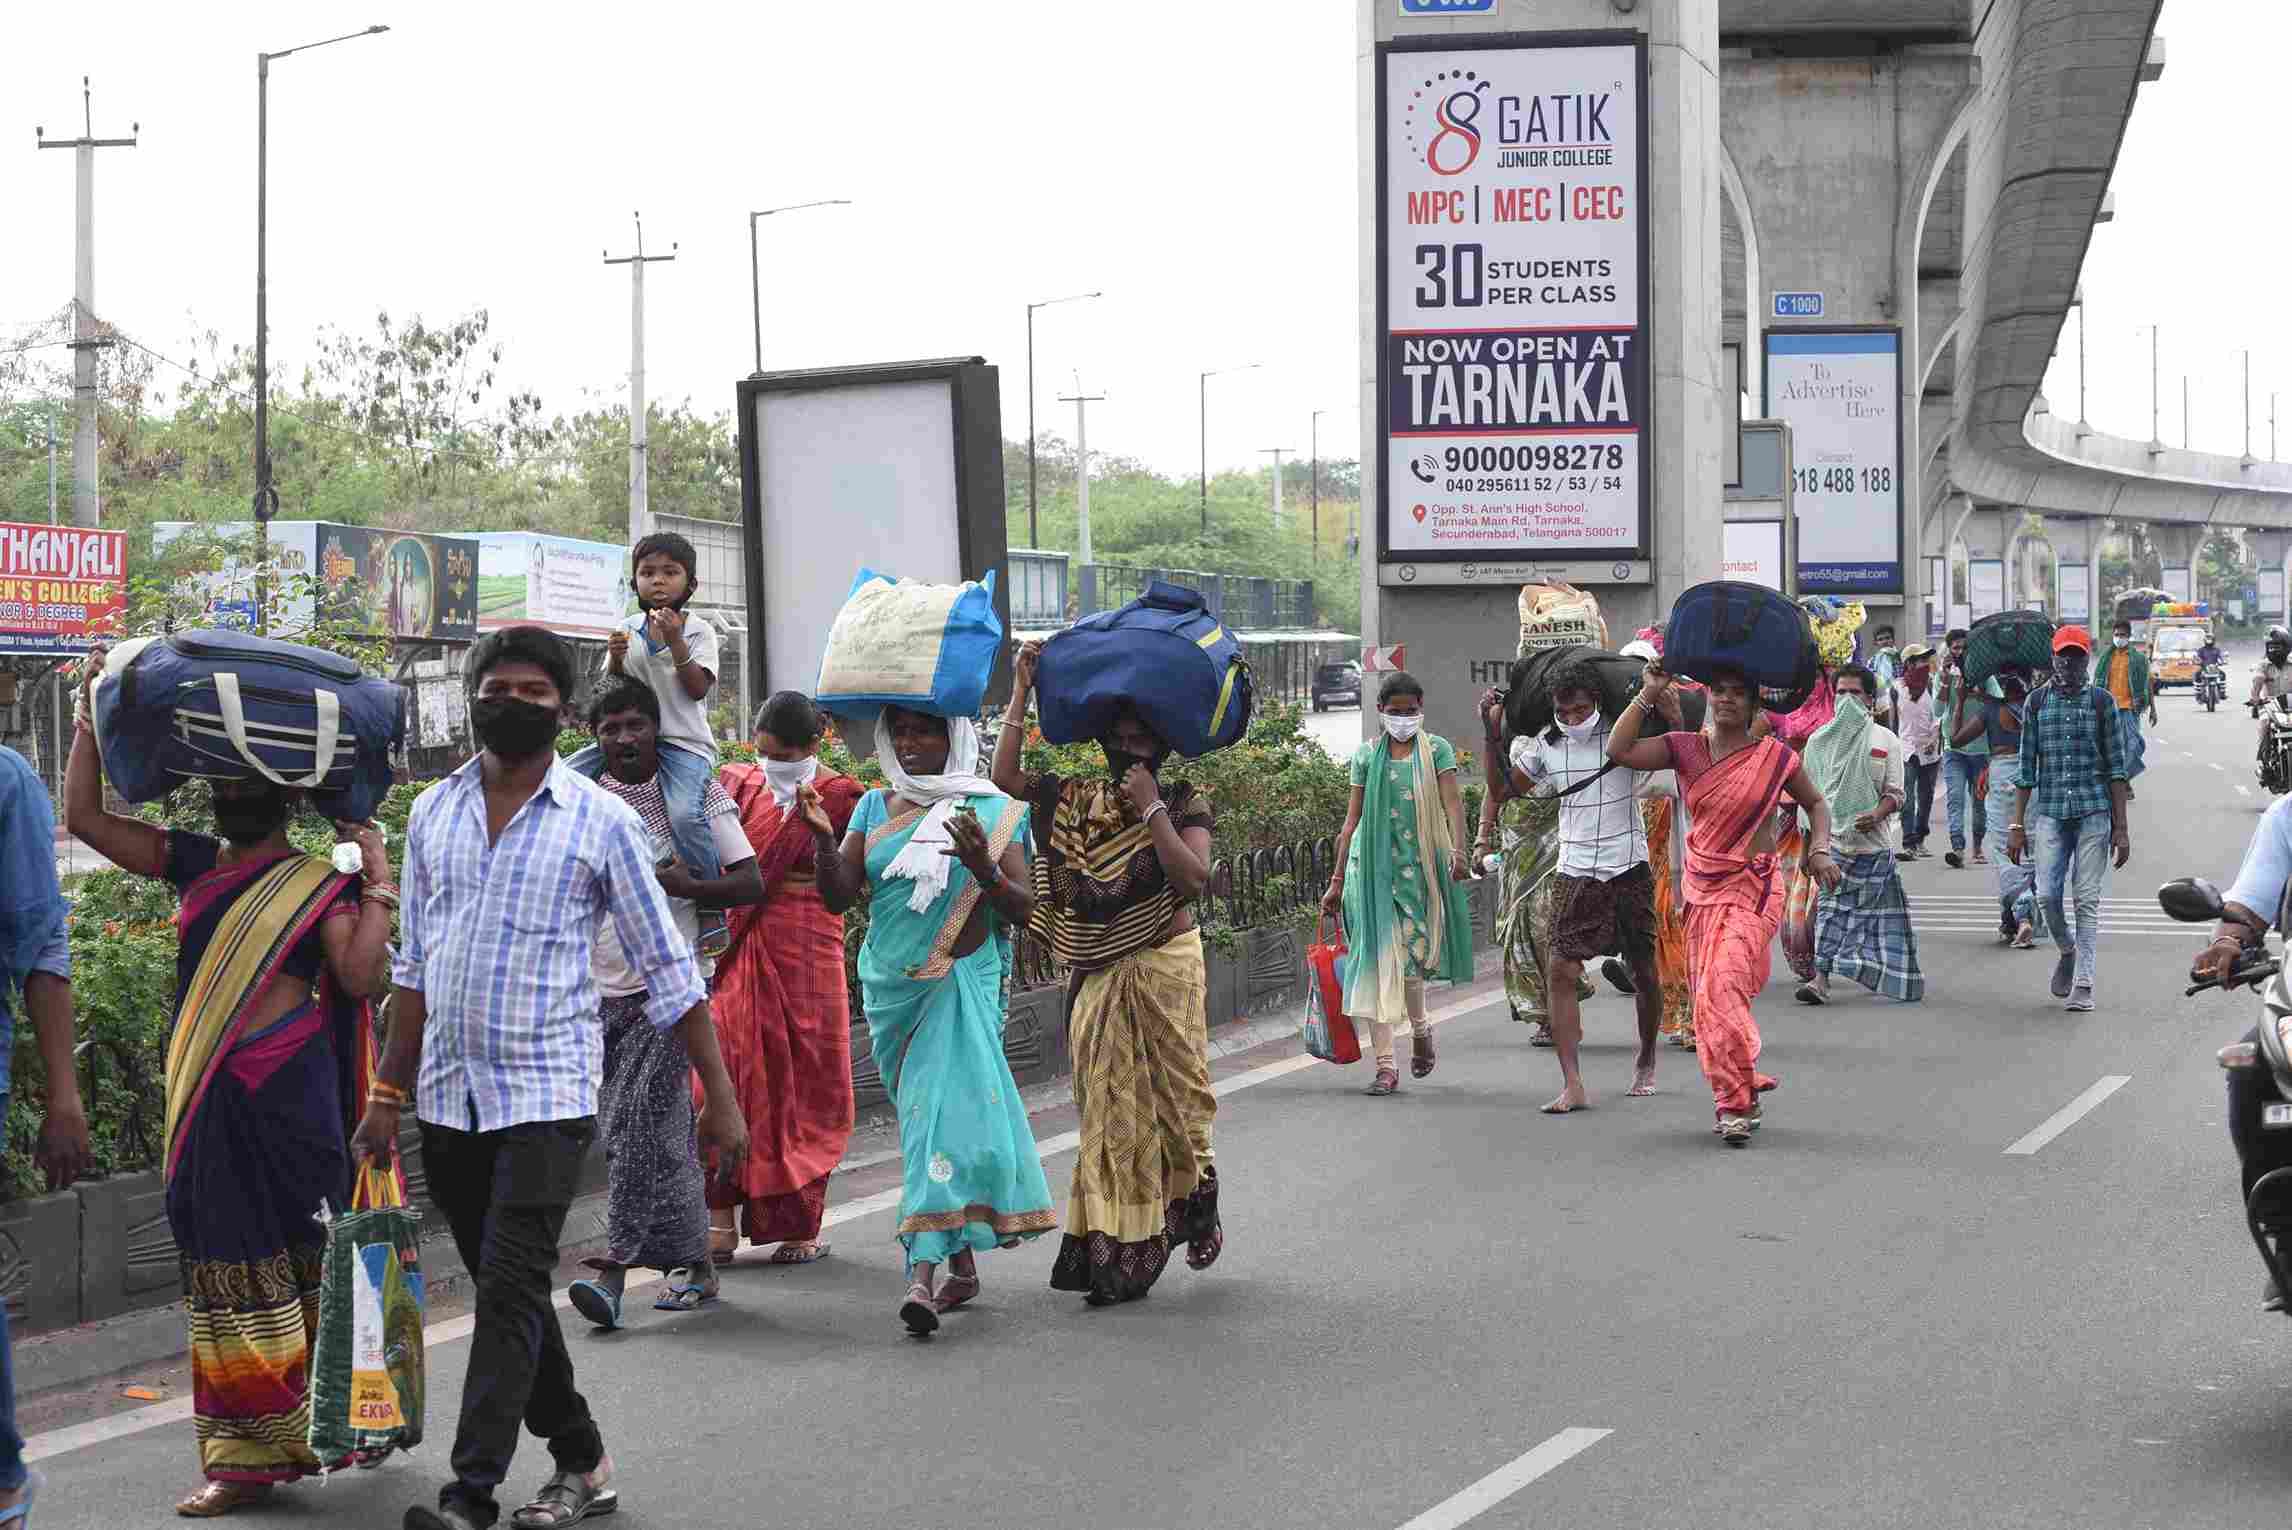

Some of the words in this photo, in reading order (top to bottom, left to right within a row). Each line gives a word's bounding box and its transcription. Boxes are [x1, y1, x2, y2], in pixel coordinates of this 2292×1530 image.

[1499, 93, 1610, 143] GATIK
[1497, 151, 1548, 168] JUNIOR
[1553, 149, 1613, 166] COLLEGE
[1408, 191, 1464, 224] MPC
[1494, 188, 1552, 222] MEC
[1573, 186, 1624, 220] CEC
[1416, 243, 1483, 308] 30
[1488, 260, 1611, 279] STUDENTS
[1488, 287, 1532, 304] PER
[1541, 285, 1616, 304] CLASS
[1779, 297, 1787, 312] C
[1792, 296, 1819, 312] 1000
[1404, 338, 1483, 363] NOW
[1491, 337, 1577, 361] OPEN
[1589, 336, 1631, 359] AT
[1809, 363, 1831, 380] To
[1402, 361, 1630, 425] TARNAKA
[1782, 378, 1875, 400] Advertise
[1845, 402, 1886, 418] Here
[1445, 445, 1623, 472] 9000098278
[1446, 478, 1473, 492] 040
[1477, 478, 1529, 492] 295611
[1534, 477, 1551, 491] 52
[1568, 477, 1586, 490] 53
[1603, 476, 1621, 490] 54
[1824, 468, 1855, 493] 488
[1861, 467, 1891, 493] 188
[1481, 503, 1513, 514] Ann's
[1515, 503, 1542, 515] High
[1433, 516, 1478, 527] Tarnaka
[1481, 516, 1508, 526] Main
[1523, 527, 1581, 540] Telangana
